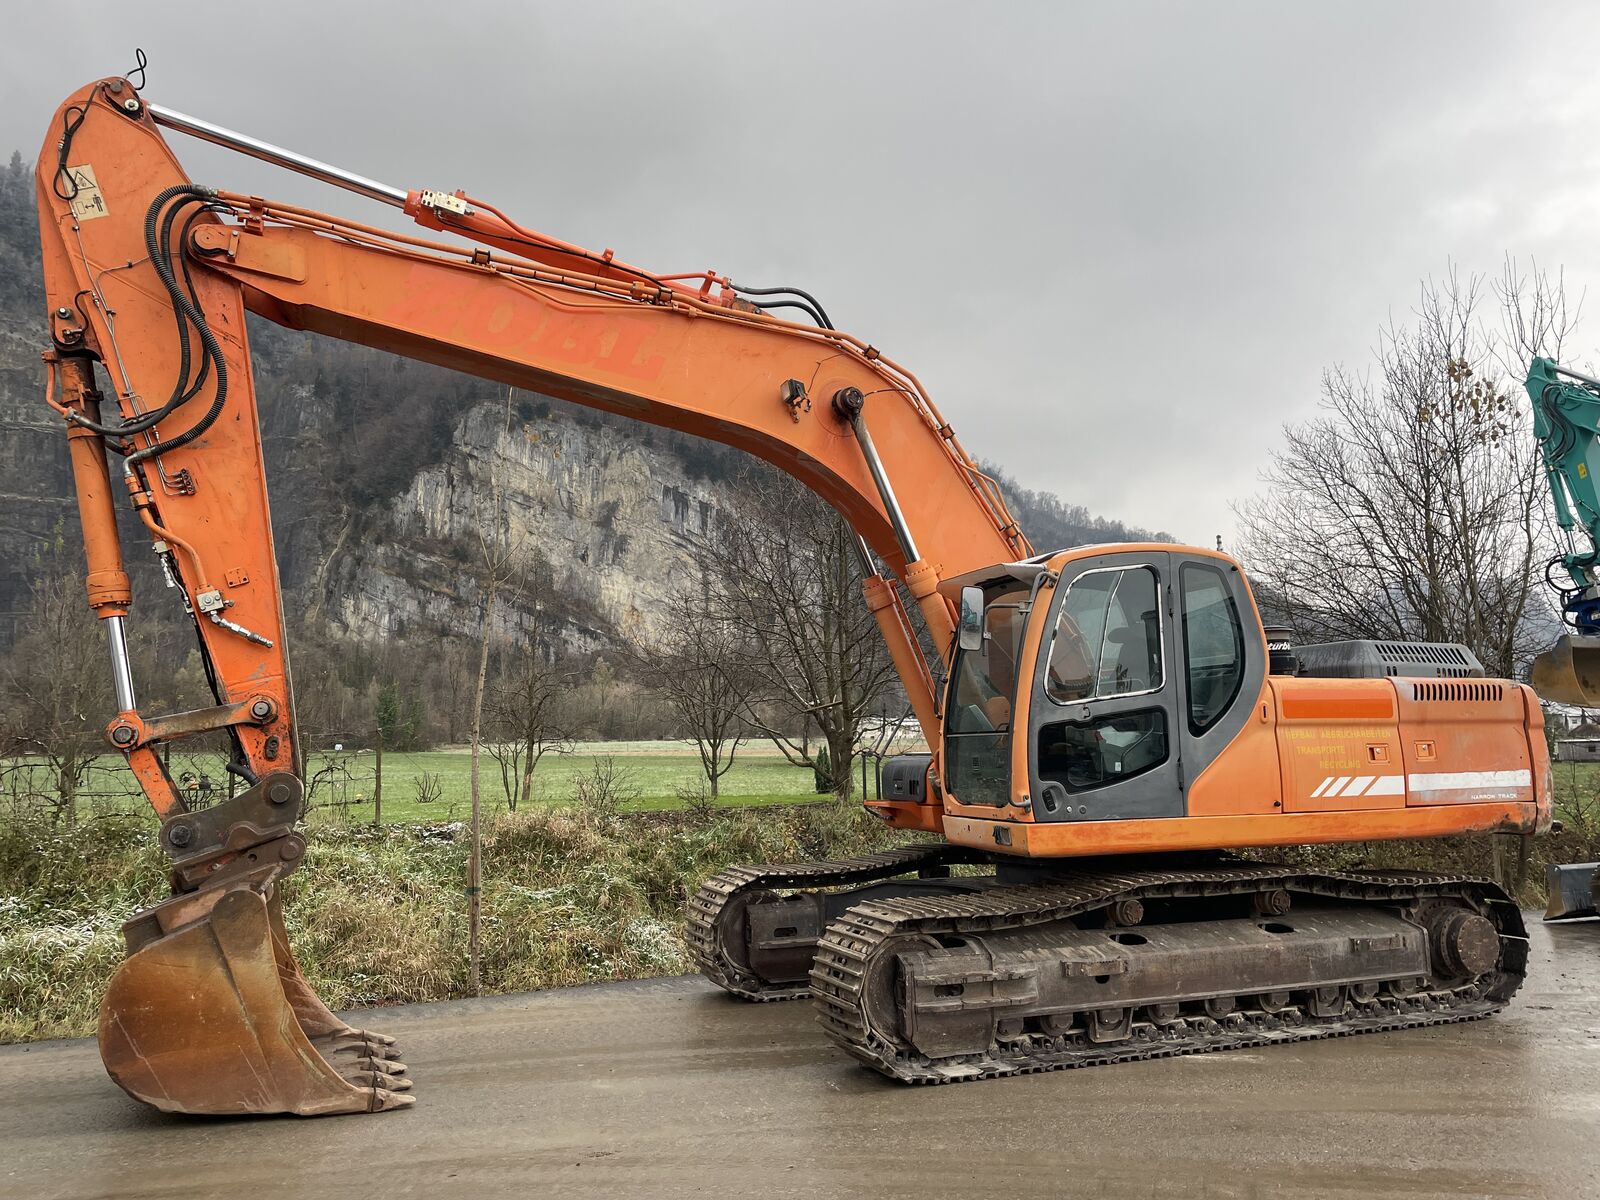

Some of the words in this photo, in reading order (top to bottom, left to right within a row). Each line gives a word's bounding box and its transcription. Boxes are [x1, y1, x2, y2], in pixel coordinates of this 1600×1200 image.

[1296, 746, 1345, 755] TRANSPORTE
[1320, 760, 1361, 769] RECYCLING
[1498, 791, 1517, 799] TRACK
